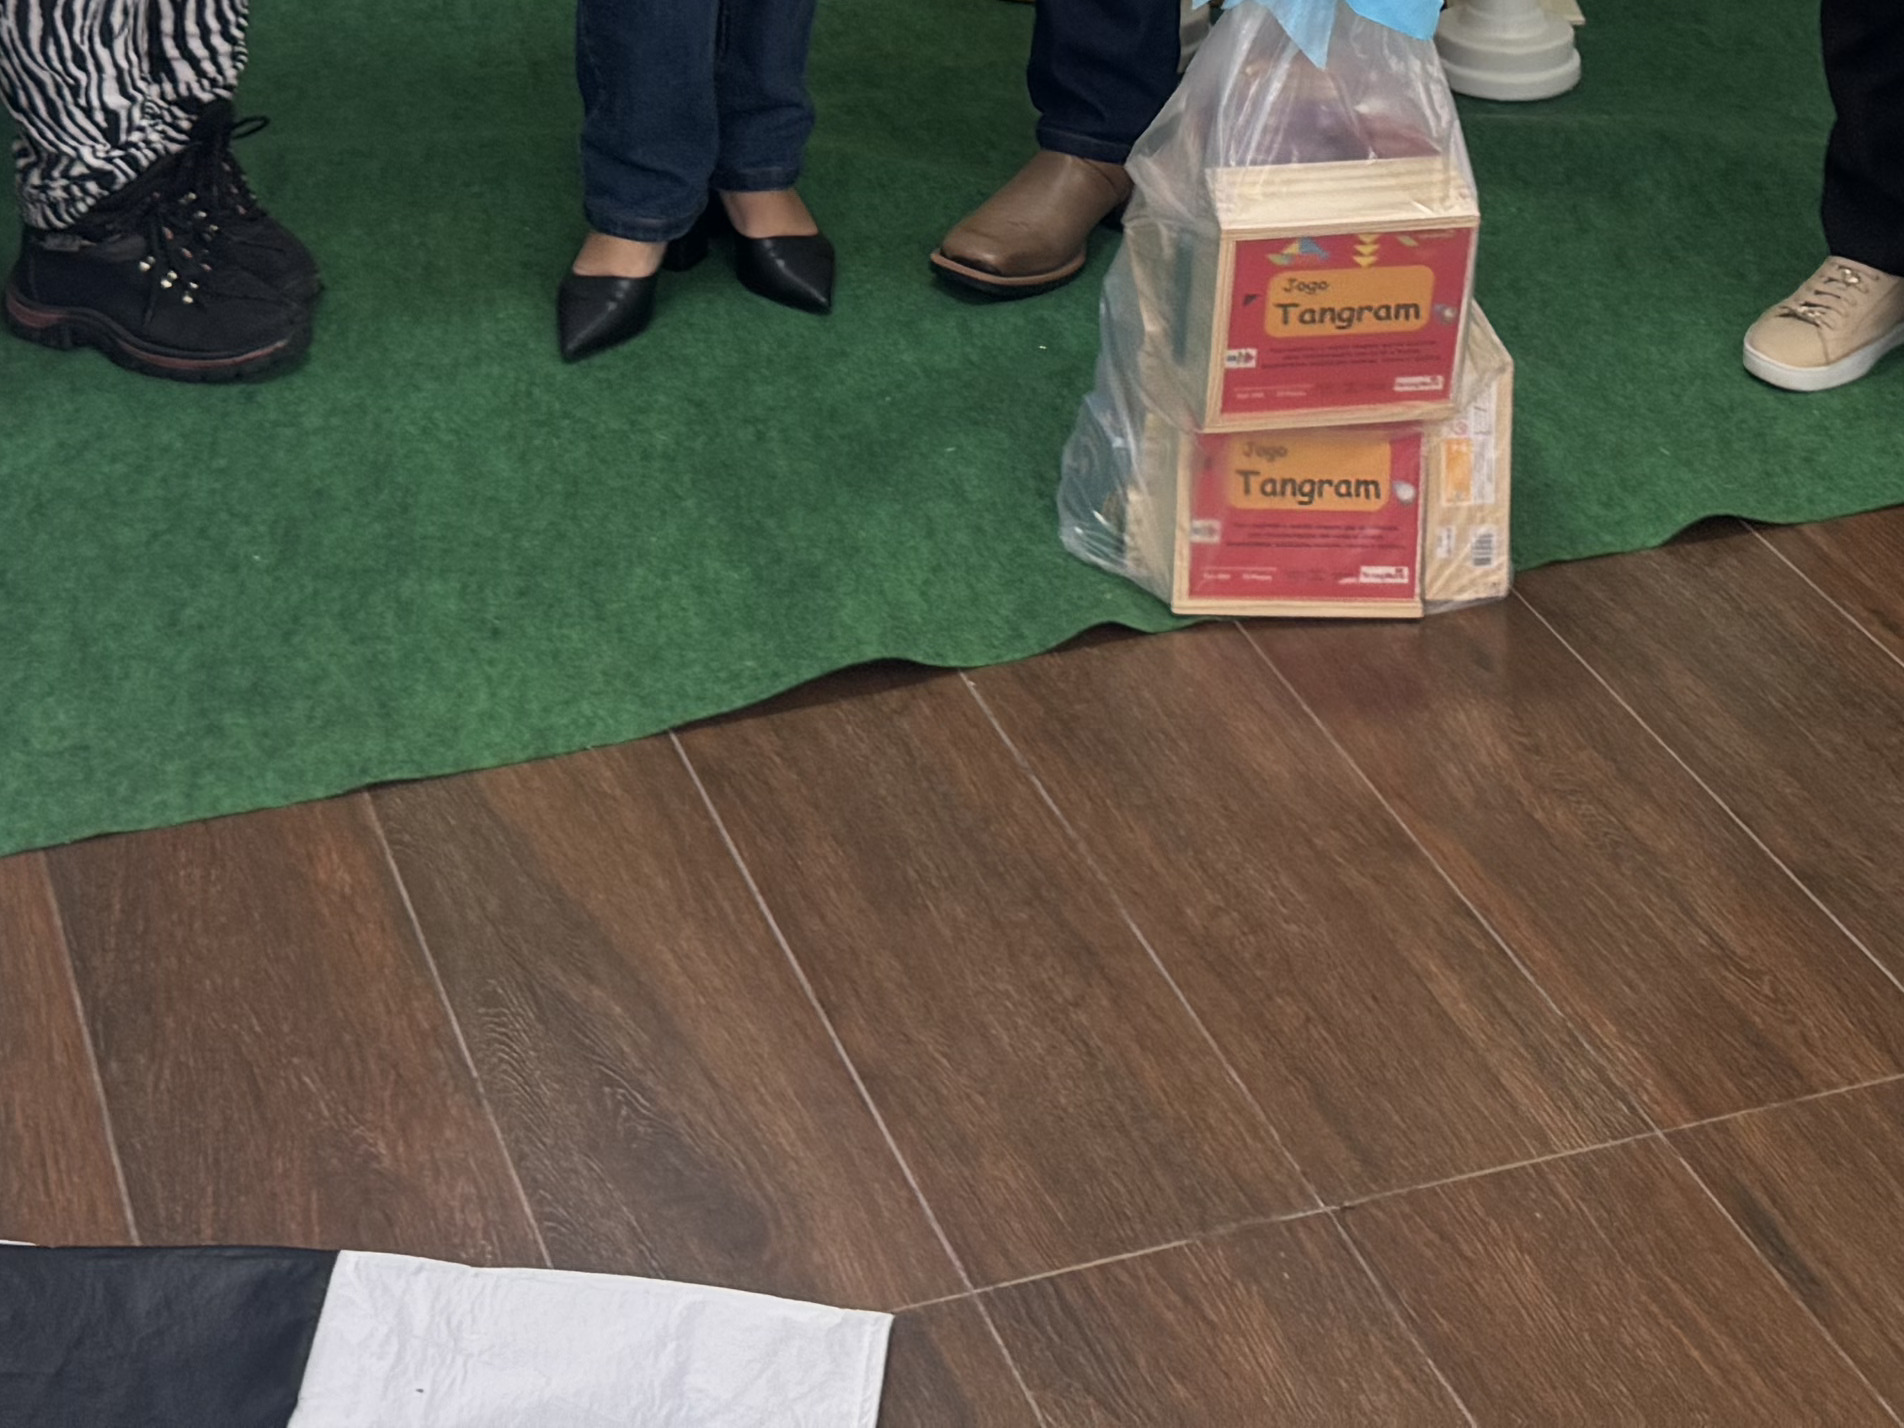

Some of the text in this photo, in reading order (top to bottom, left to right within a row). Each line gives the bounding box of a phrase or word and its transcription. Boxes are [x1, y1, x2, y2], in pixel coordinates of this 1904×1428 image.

[1282, 278, 1331, 294] Jogo
[1271, 301, 1421, 331] Tangram
[1234, 468, 1382, 507] Tangram
